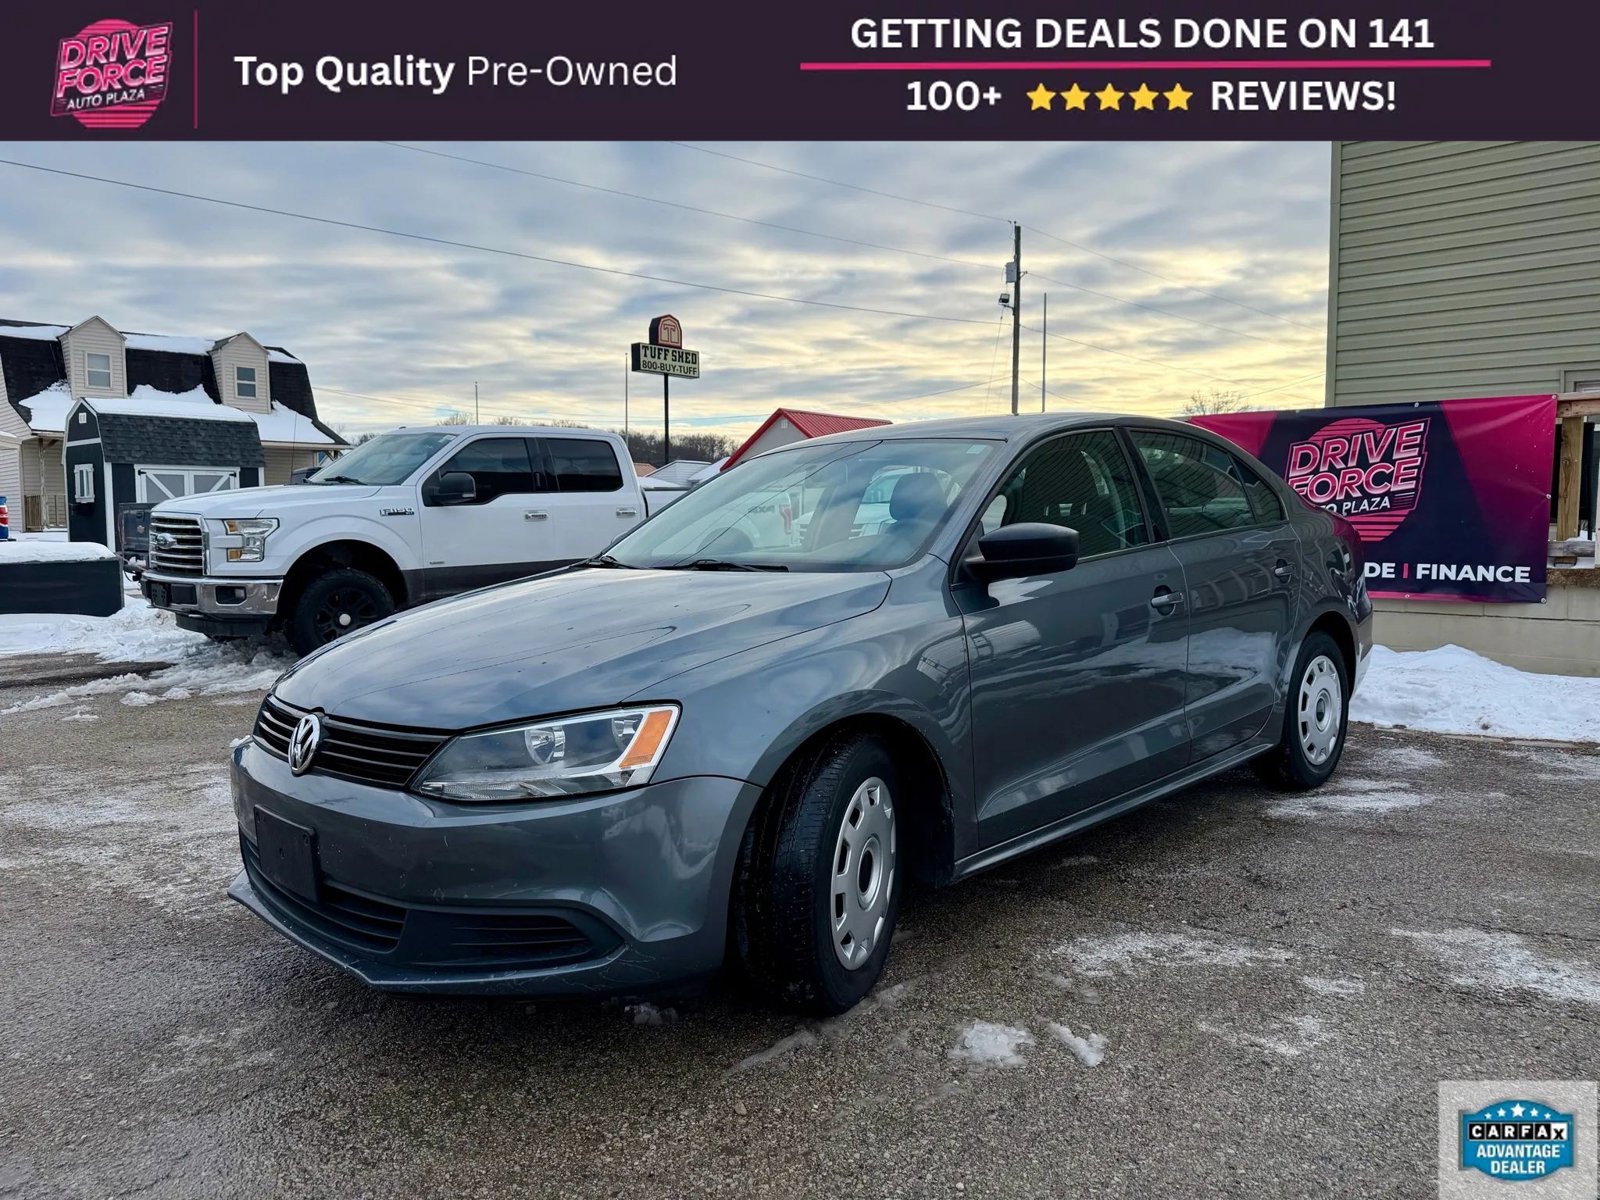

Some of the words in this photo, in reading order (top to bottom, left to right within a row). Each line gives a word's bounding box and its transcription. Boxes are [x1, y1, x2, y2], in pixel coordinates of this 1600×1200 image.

[642, 346, 669, 360] TUFF
[671, 350, 697, 364] SHED
[1288, 422, 1426, 478] DRIVE
[1288, 456, 1422, 504] FORCE
[1341, 495, 1391, 516] PLAZA
[1363, 561, 1396, 579] DE
[1416, 562, 1531, 583] FINANCE
